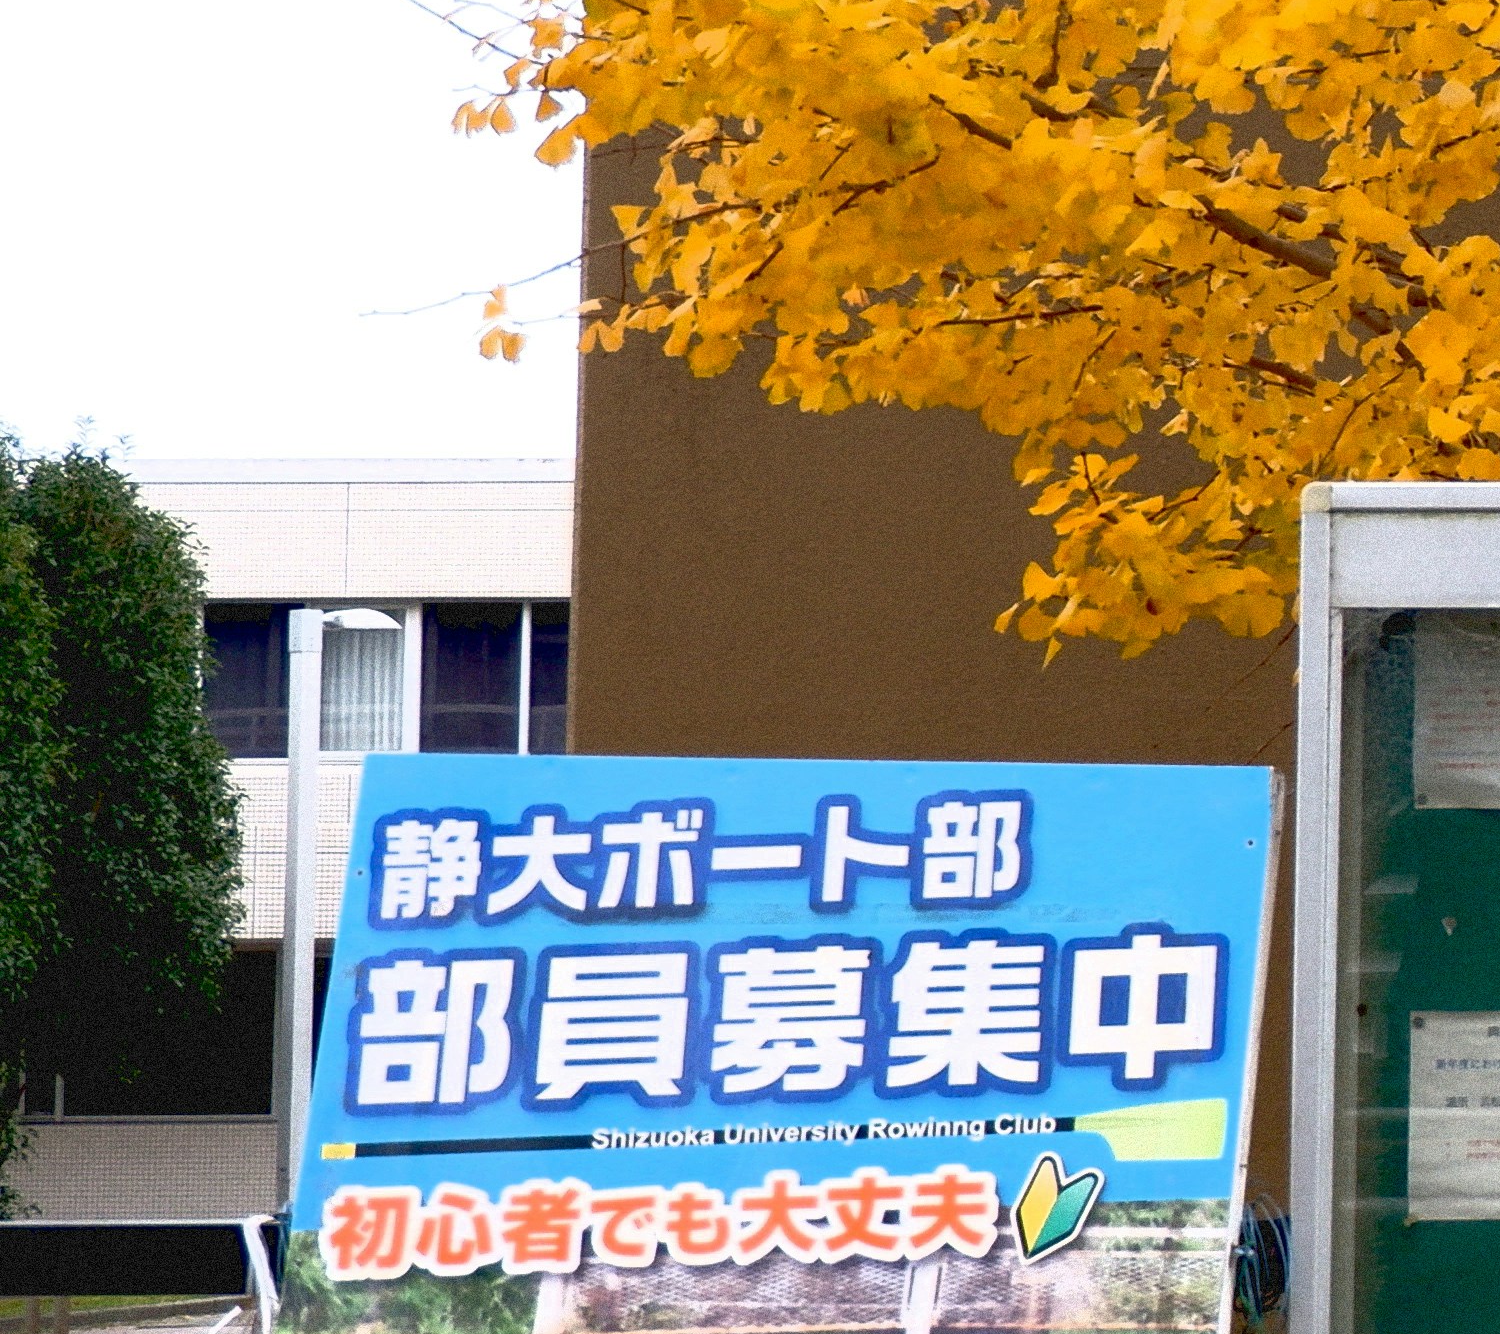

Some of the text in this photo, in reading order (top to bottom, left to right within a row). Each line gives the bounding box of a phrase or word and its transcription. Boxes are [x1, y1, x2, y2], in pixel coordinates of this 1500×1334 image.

[377, 797, 1026, 921] 静大ボート部
[355, 932, 1222, 1110] 部員募集中
[591, 1127, 716, 1150] Shizuoka
[724, 1122, 858, 1146] University
[994, 1114, 1057, 1135] Club
[327, 1169, 993, 1273] 初心者でも大丈夫
